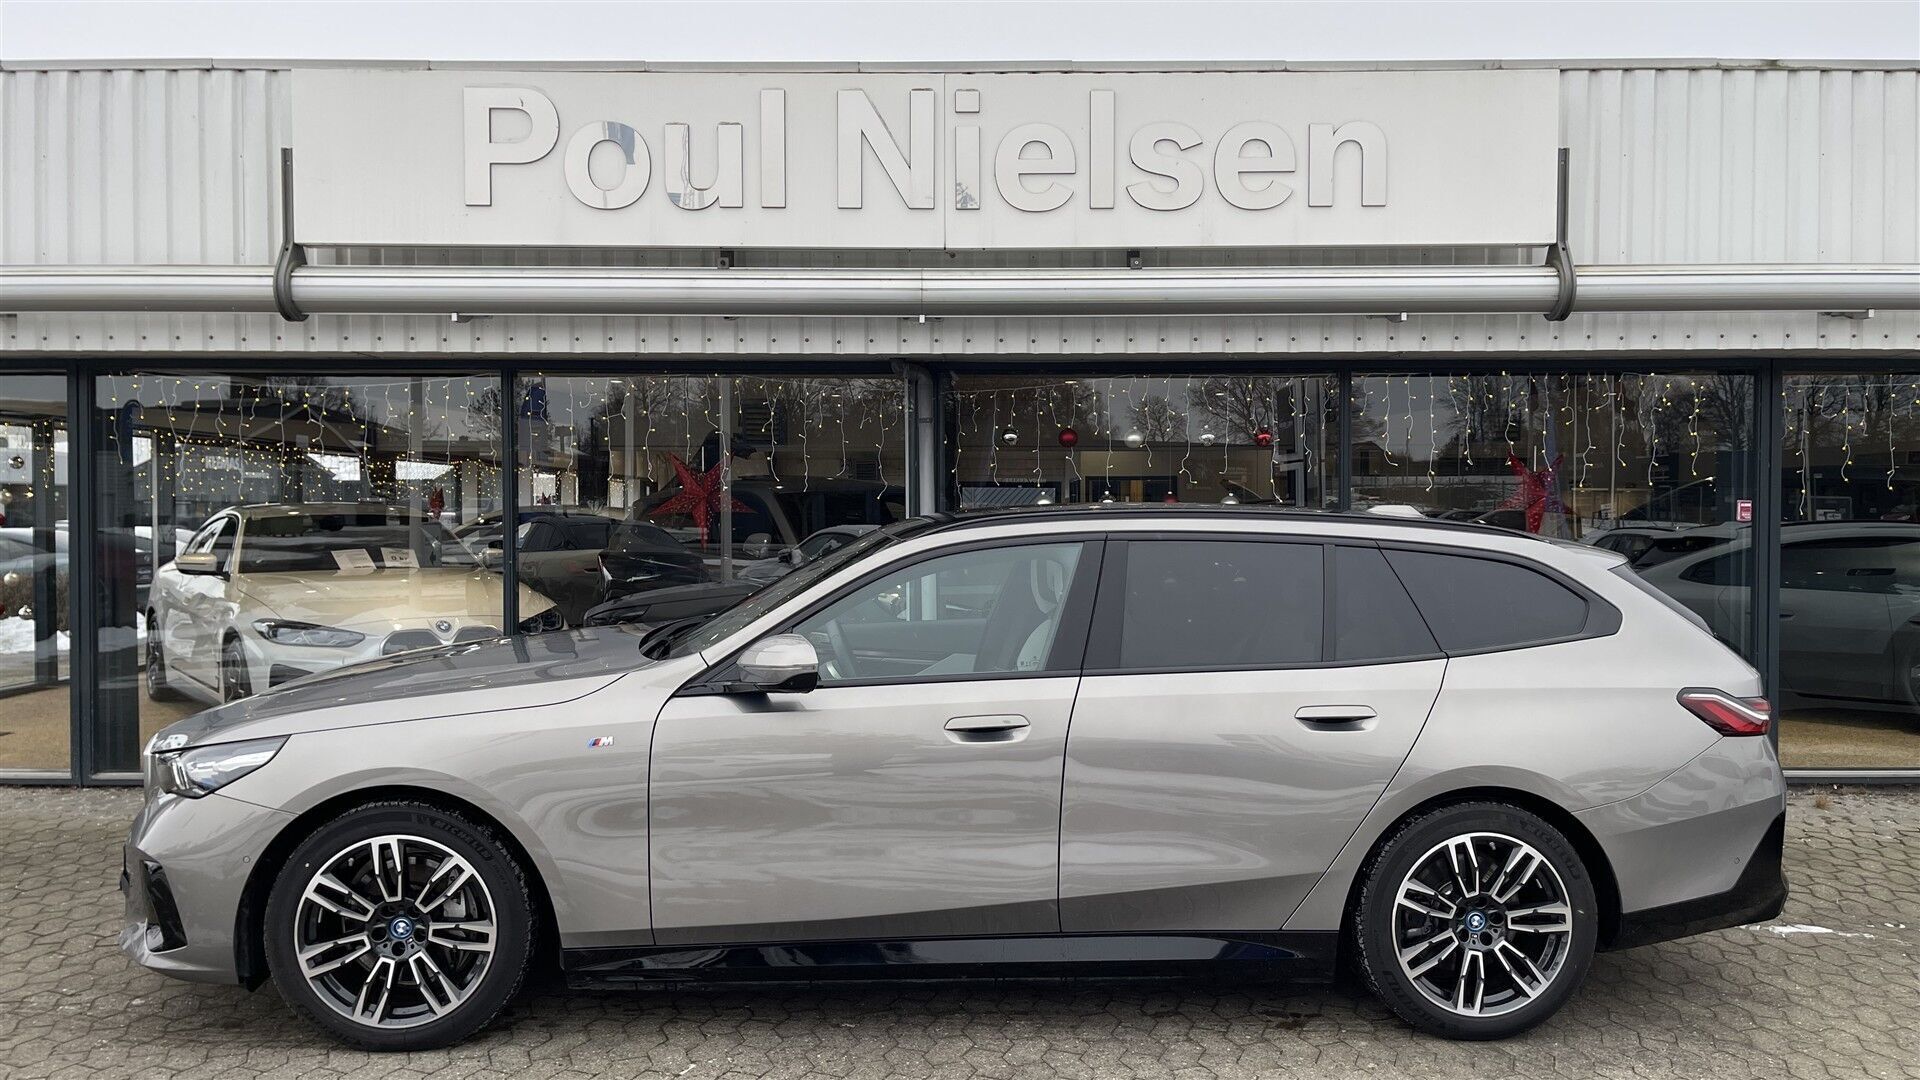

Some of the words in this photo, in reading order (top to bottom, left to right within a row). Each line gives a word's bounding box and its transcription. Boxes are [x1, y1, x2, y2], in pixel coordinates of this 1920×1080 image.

[463, 86, 787, 211] Poul
[837, 88, 1389, 213] Nielsen
[597, 736, 614, 747] M
[432, 819, 492, 861] MICHELIN
